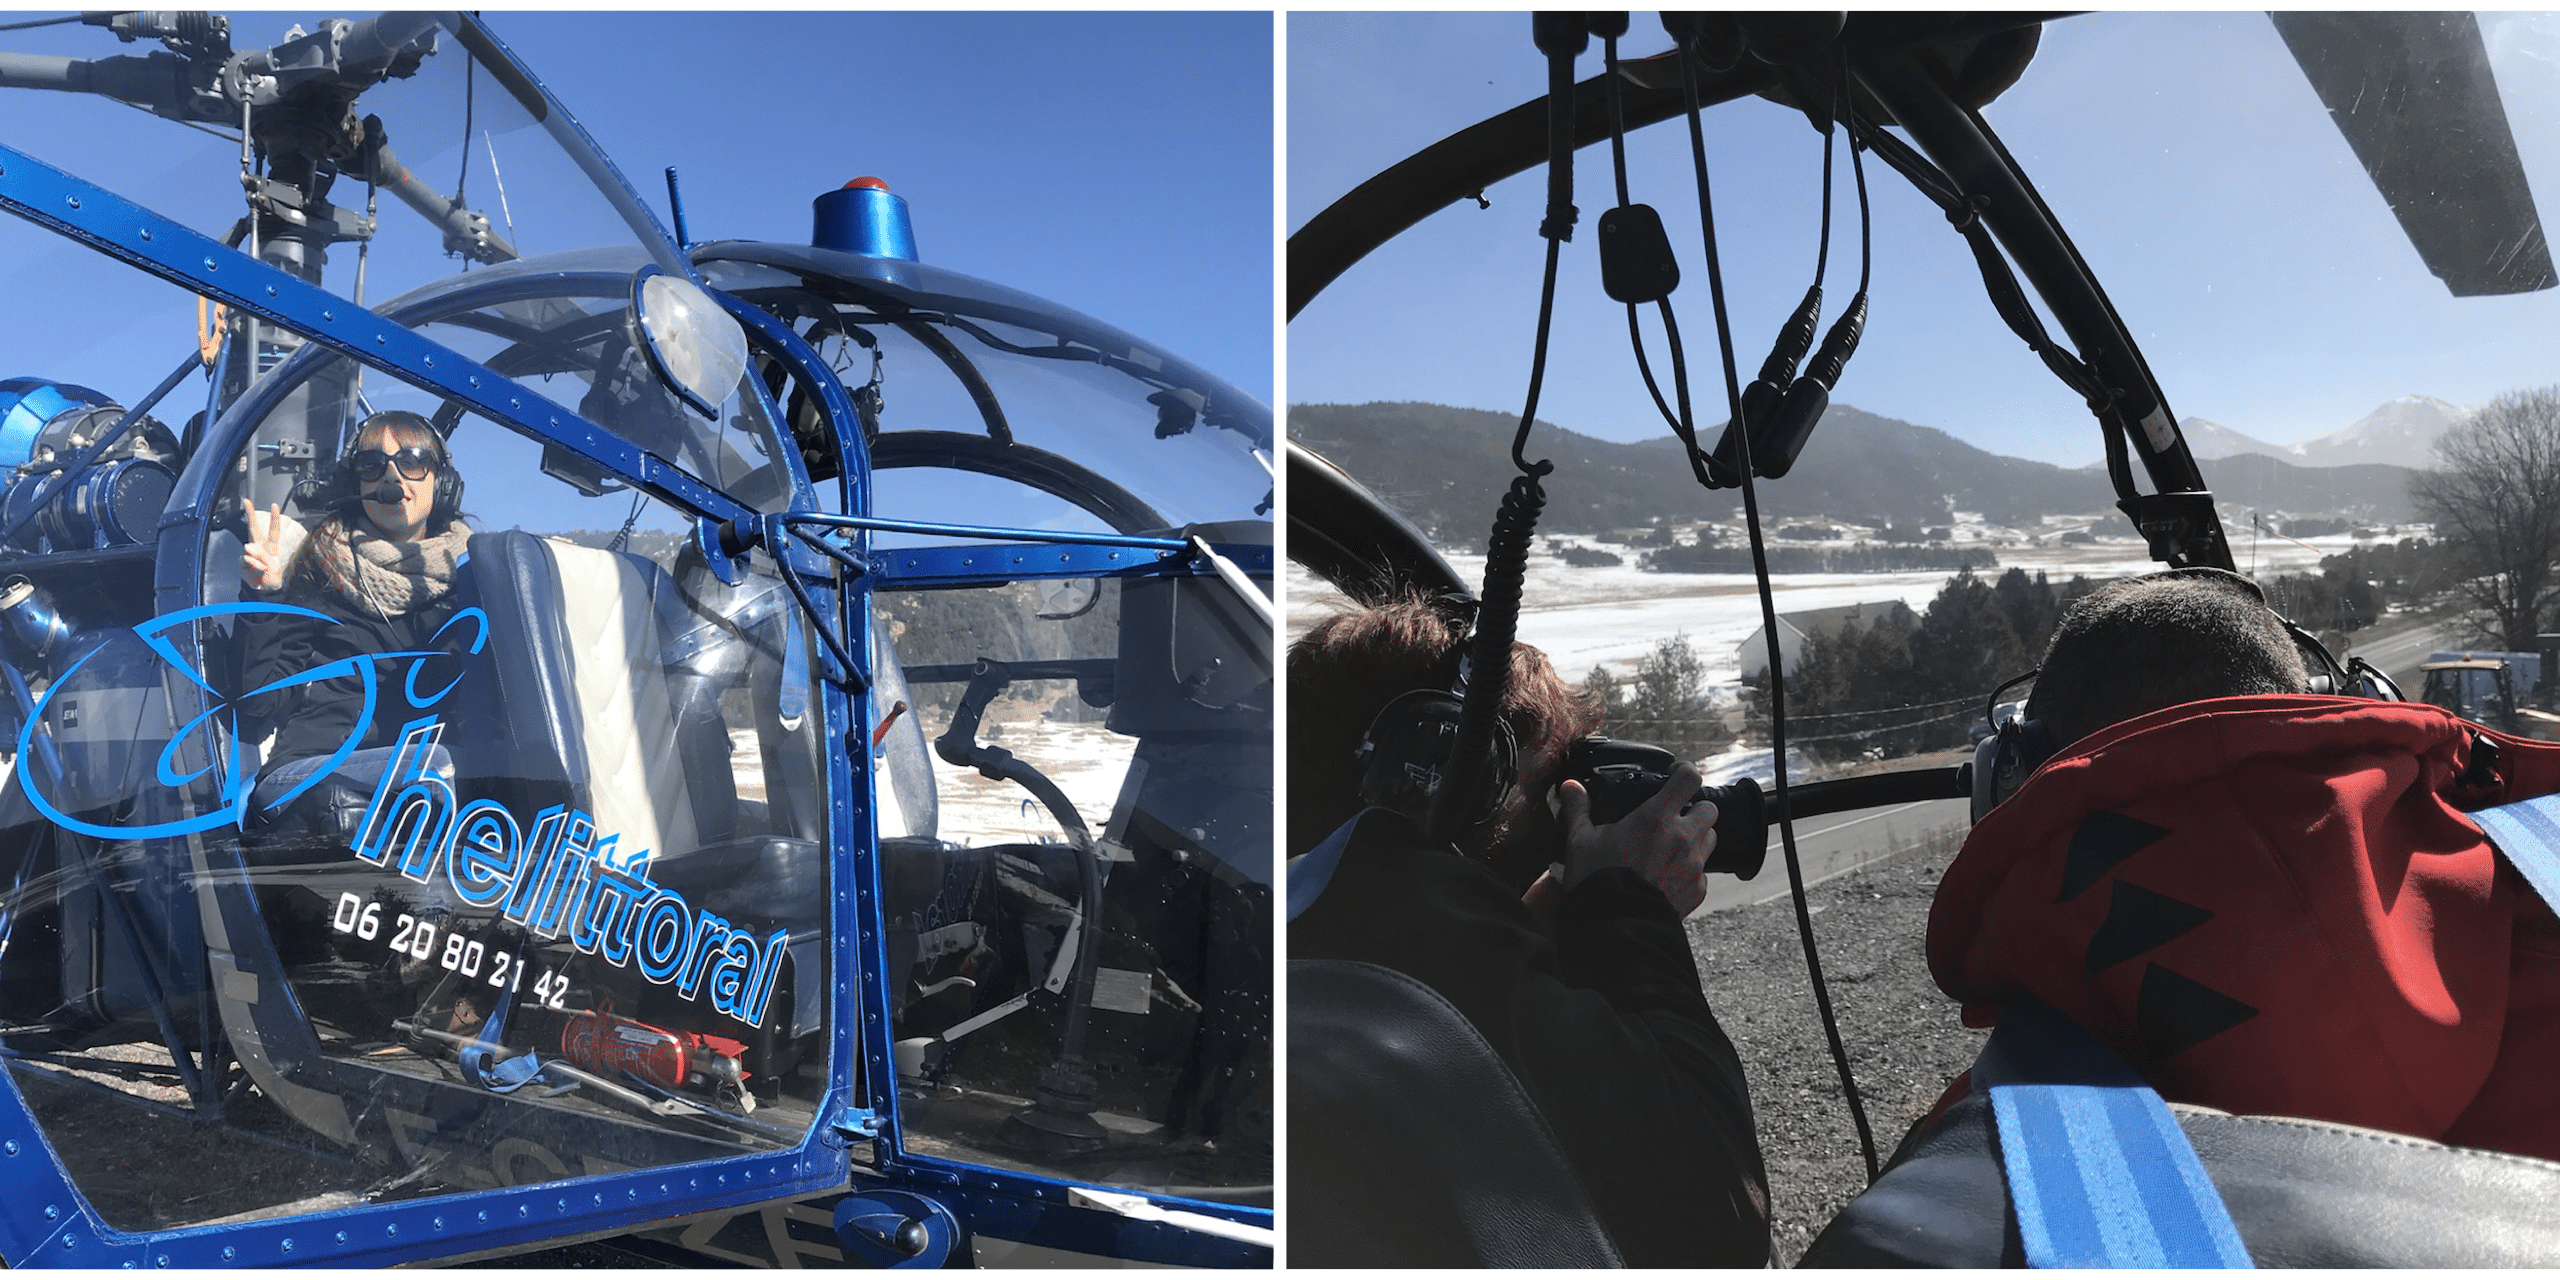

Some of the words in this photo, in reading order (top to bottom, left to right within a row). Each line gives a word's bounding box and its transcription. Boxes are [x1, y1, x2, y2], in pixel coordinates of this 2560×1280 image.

[333, 892, 381, 941] 06
[389, 913, 436, 960] 20
[441, 933, 485, 978] 80
[488, 951, 525, 993] 21
[533, 970, 569, 1010] 42
[350, 714, 789, 1029] helittoral
